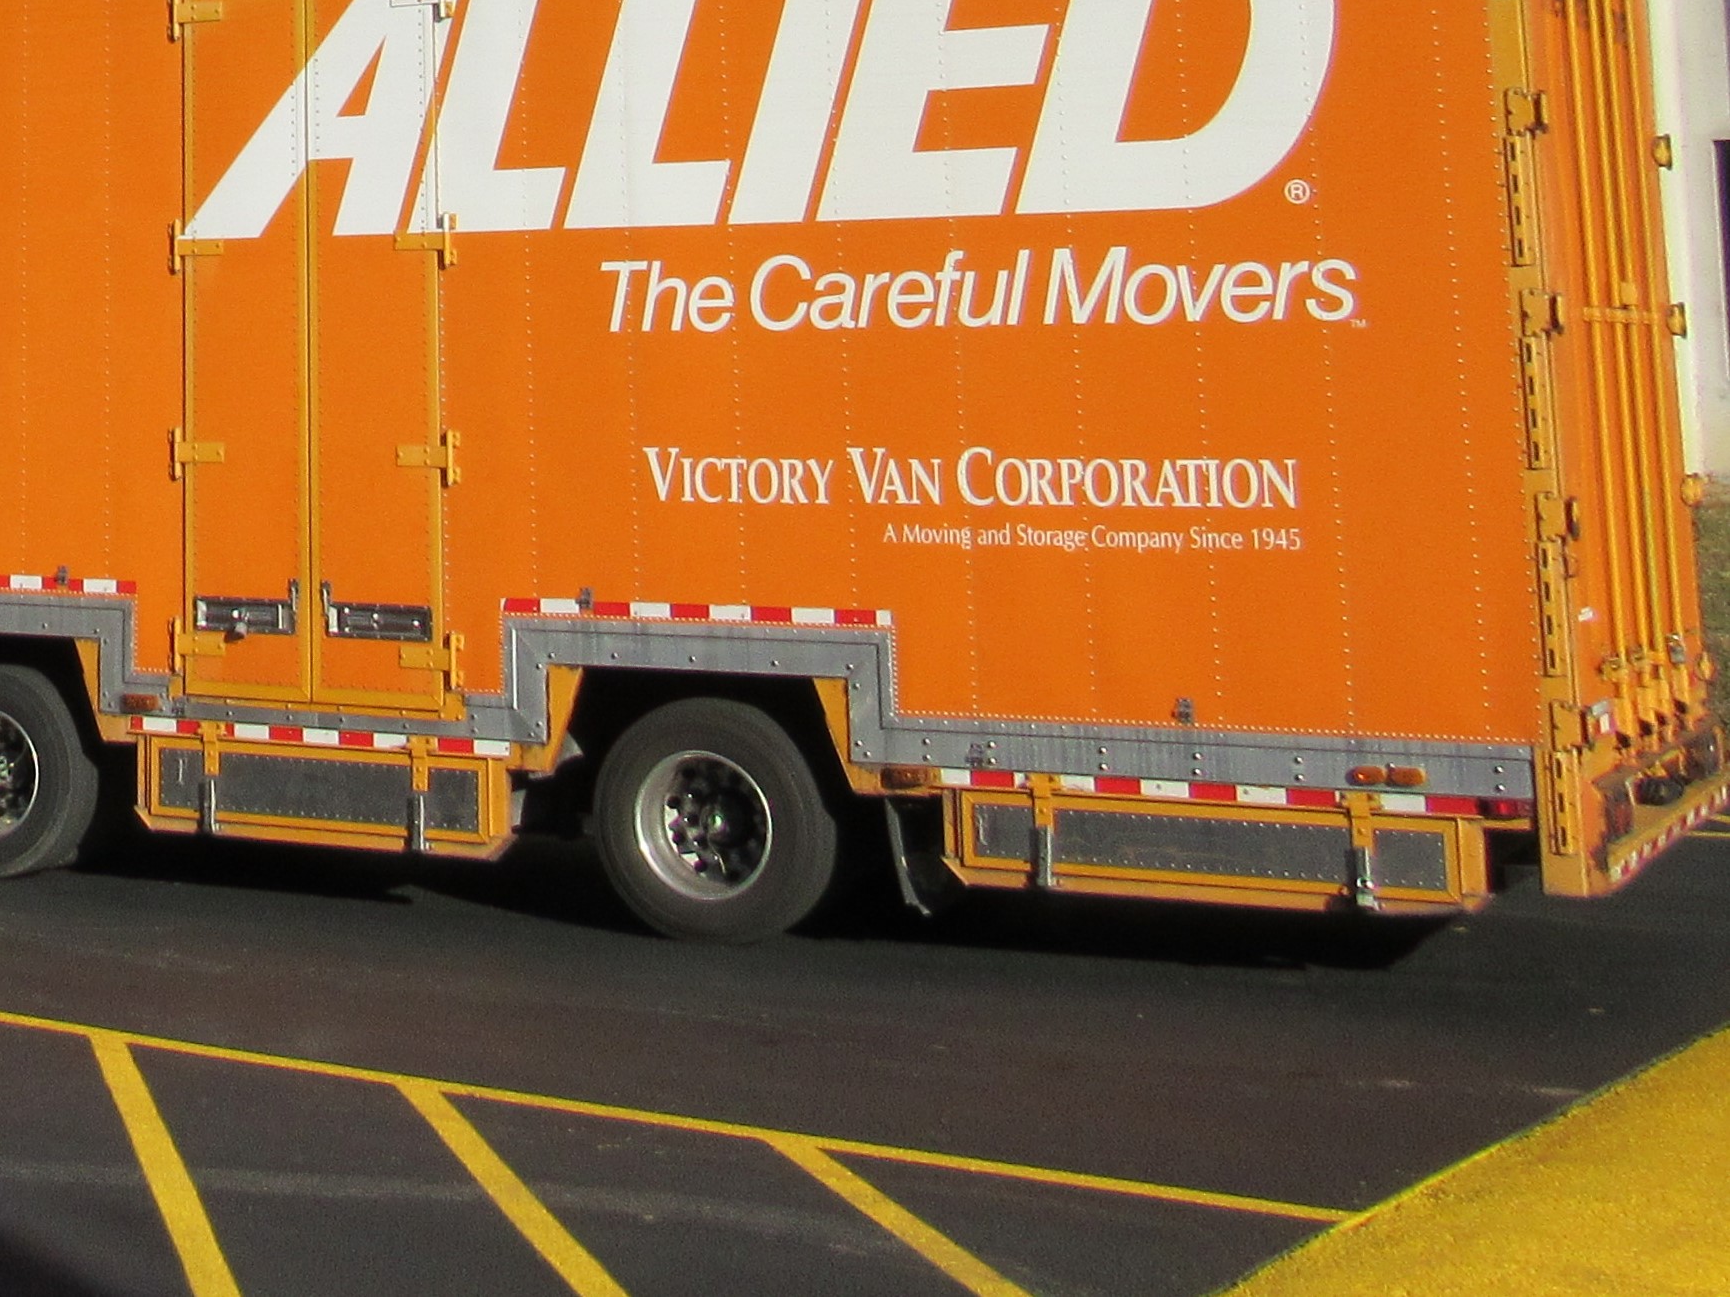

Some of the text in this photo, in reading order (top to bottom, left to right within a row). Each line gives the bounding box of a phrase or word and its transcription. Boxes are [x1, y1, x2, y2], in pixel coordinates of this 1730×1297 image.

[600, 246, 1358, 333] The Careful Movers
[882, 522, 1301, 553] A Moving and Storage Company Since 1945
